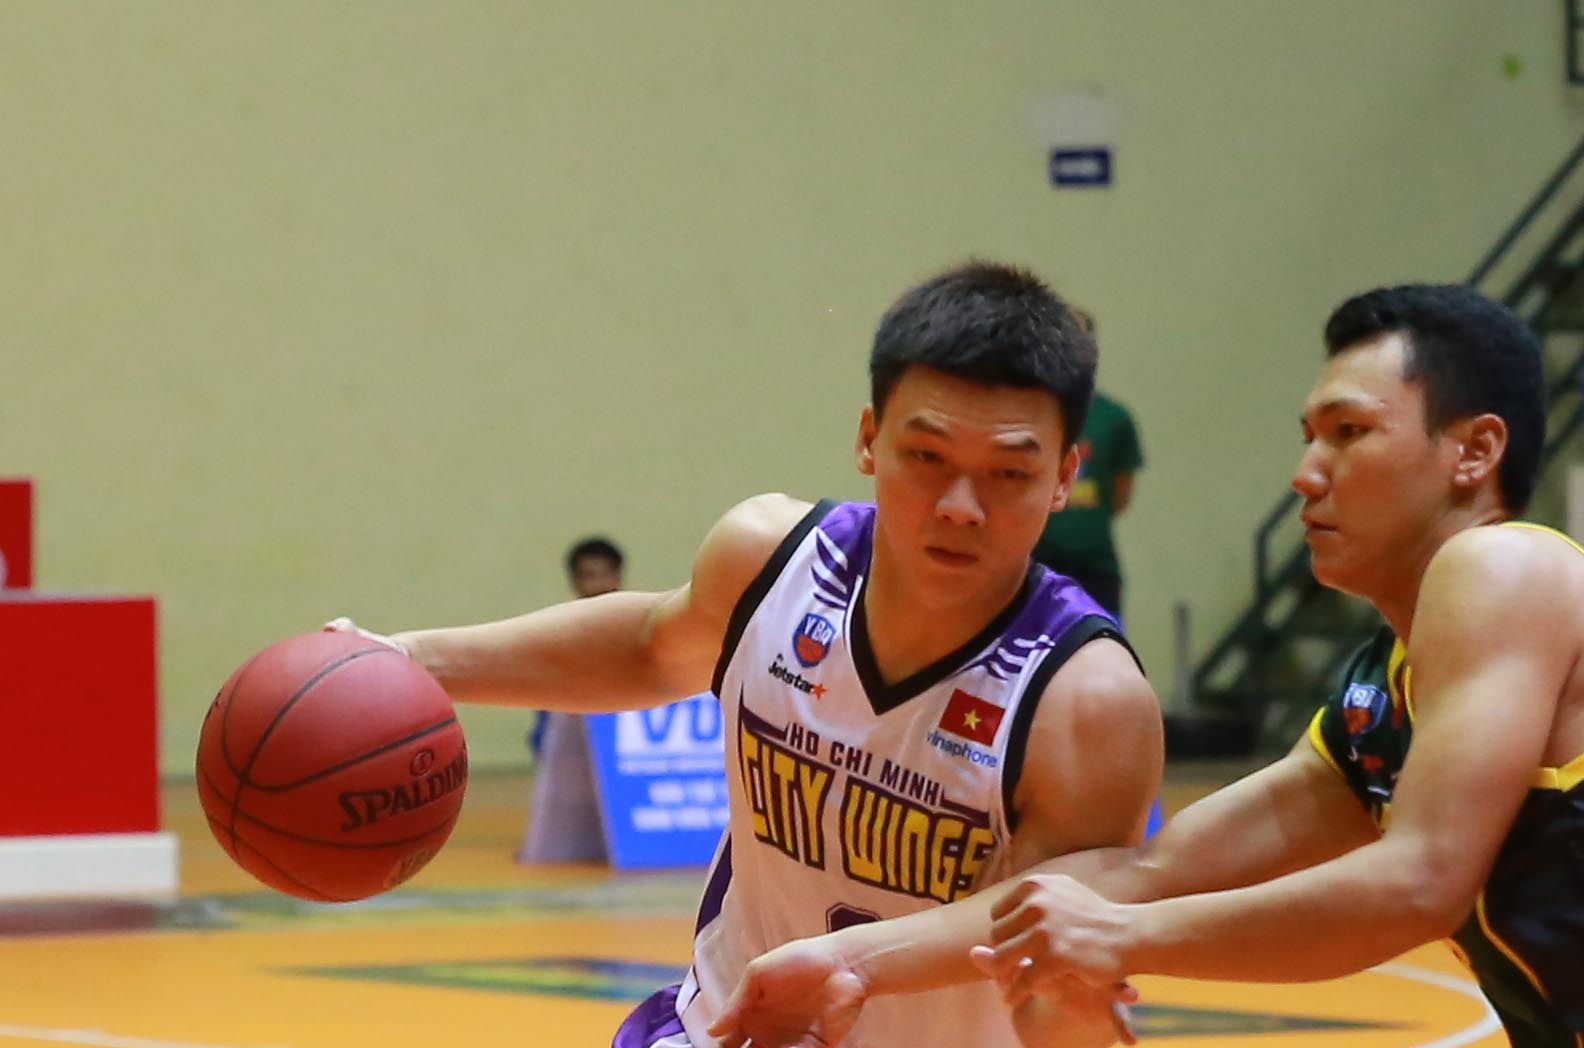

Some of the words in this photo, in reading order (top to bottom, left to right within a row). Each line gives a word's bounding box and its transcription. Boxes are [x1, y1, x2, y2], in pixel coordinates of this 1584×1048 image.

[768, 661, 815, 695] Jetstar
[338, 742, 468, 833] SPALDIN
[739, 718, 835, 871] CITY
[840, 773, 998, 904] WINGS
[829, 740, 873, 776] CHI
[880, 759, 942, 806] MINH
